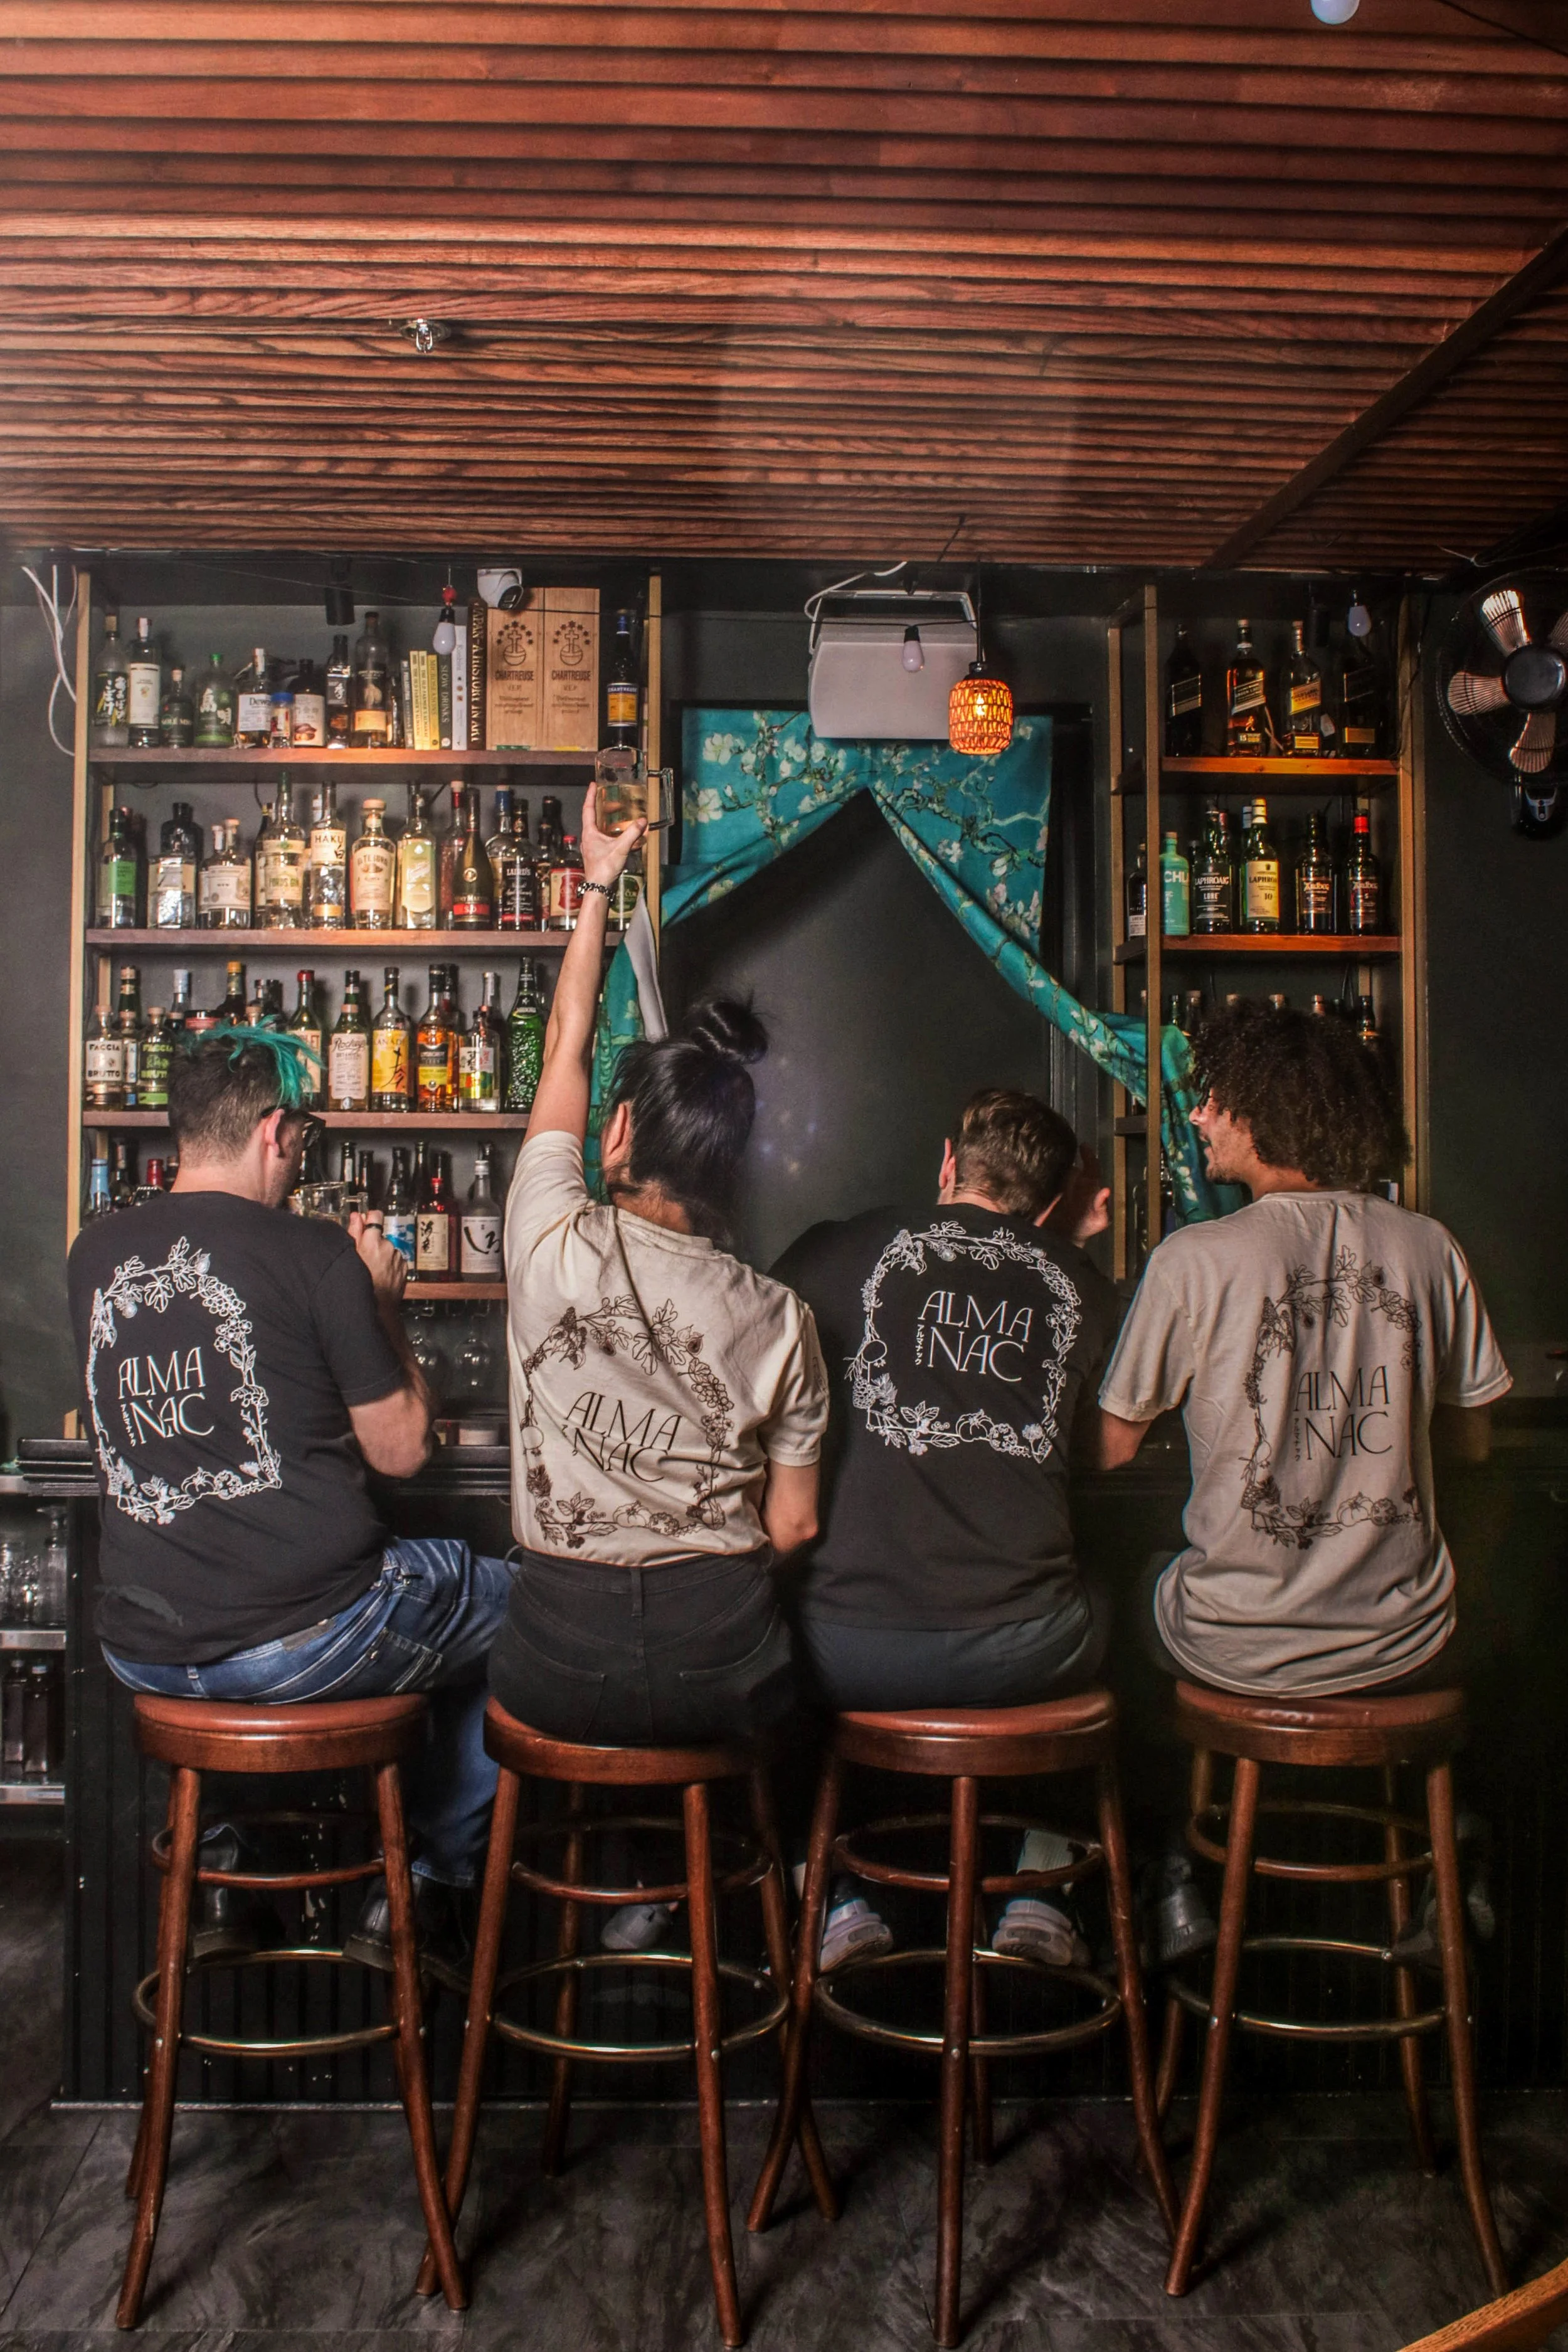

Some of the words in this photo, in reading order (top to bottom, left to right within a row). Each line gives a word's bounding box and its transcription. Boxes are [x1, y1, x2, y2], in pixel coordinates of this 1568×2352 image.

[440, 665, 449, 689] SLOW
[495, 670, 534, 681] CHARTREUSE
[551, 670, 591, 681] CHARTREUSE
[441, 693, 450, 723] DRINKS
[471, 720, 483, 742] ART
[314, 835, 344, 843] HAKU
[1195, 876, 1230, 886] LAPHROAIG
[1264, 893, 1273, 901] 10
[88, 1044, 120, 1052] FACCIA
[142, 1044, 174, 1052] FACCIA
[87, 1070, 120, 1078] BRUTTO
[918, 1290, 1034, 1343] ALMA
[914, 1324, 925, 1365] アルマナック
[928, 1327, 1025, 1382] NAC
[118, 1346, 206, 1400] ALMA
[1293, 1365, 1391, 1412] ALMA
[130, 1392, 215, 1444] NAC
[564, 1391, 683, 1451] ALMA
[1304, 1411, 1394, 1460] NAC
[574, 1428, 669, 1483] NAC
